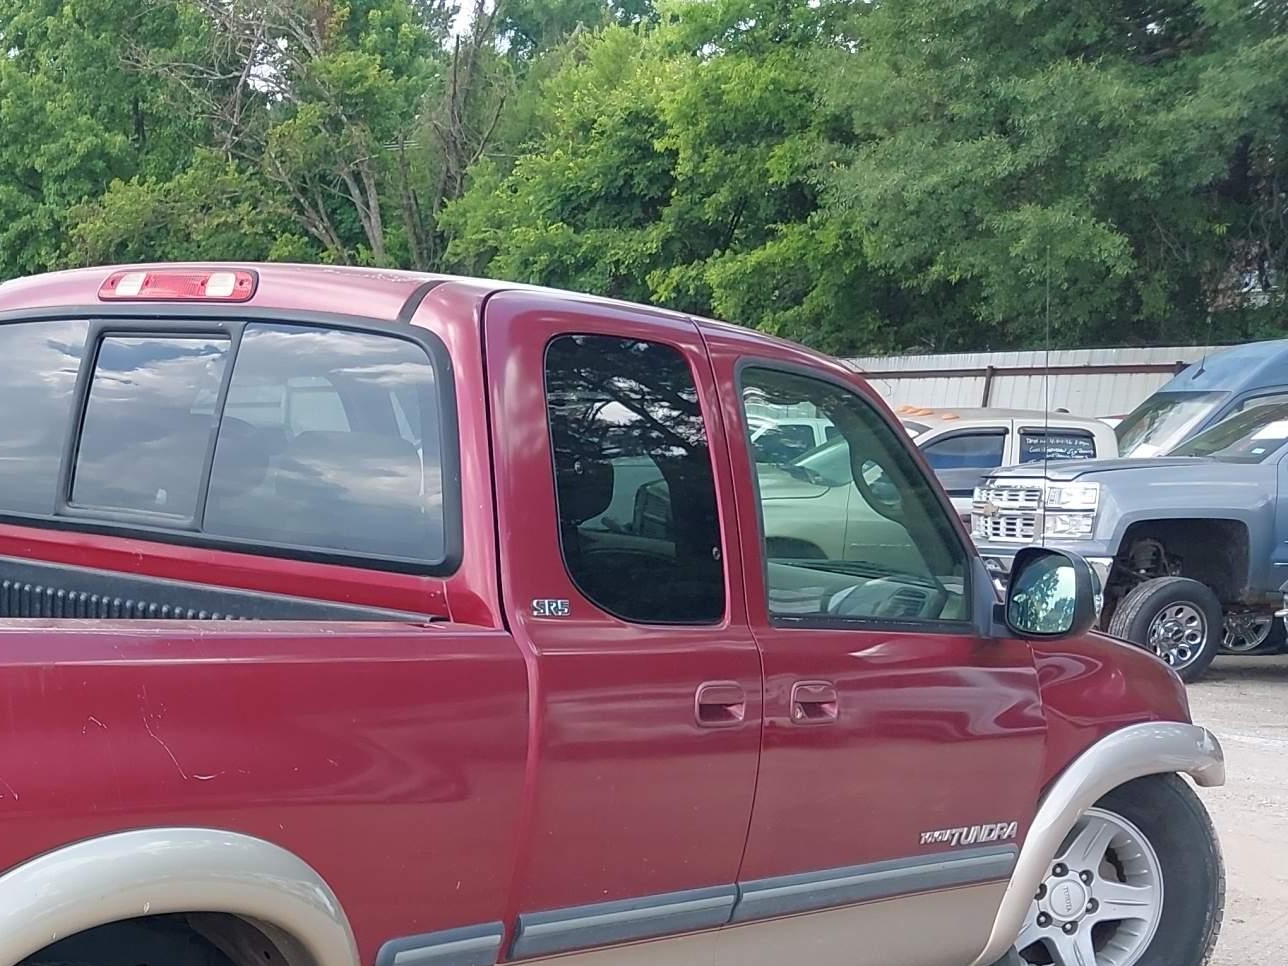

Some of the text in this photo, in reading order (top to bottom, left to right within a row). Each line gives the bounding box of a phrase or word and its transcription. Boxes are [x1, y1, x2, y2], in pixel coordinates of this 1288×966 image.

[532, 599, 570, 616] SR5
[920, 821, 1018, 846] TOYOTA TUNDRA
